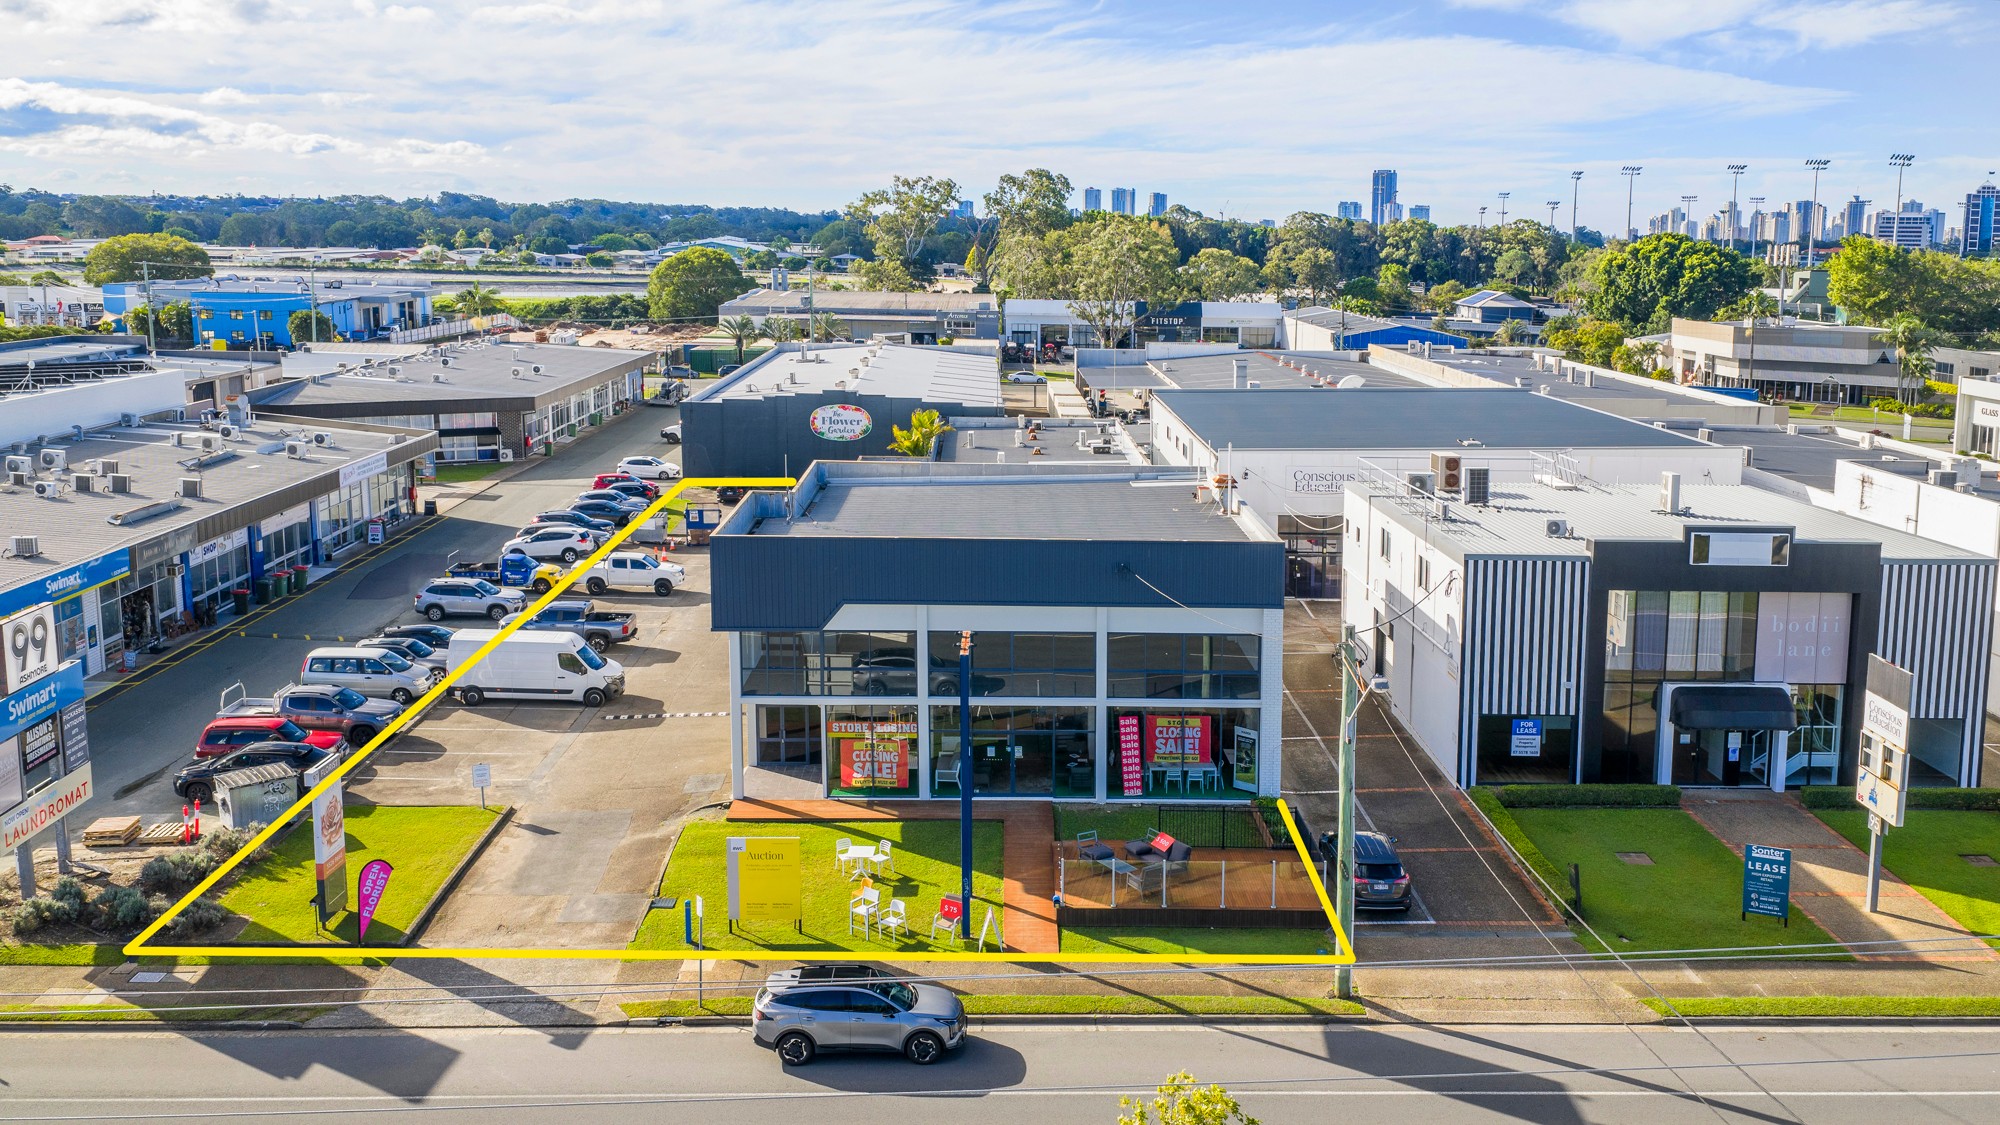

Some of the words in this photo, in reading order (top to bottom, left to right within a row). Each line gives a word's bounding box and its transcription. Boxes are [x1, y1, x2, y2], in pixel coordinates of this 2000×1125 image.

[832, 410, 843, 418] The
[1981, 407, 1999, 417] GLASS
[821, 416, 863, 425] Flower
[827, 426, 857, 434] Garden
[1293, 470, 1356, 482] Conscious
[203, 542, 217, 556] SHOP
[45, 570, 80, 595] Swimart
[1771, 614, 1839, 633] bodii
[11, 613, 48, 672] 99
[1777, 639, 1831, 657] lane
[20, 664, 48, 685] ASHMORE
[8, 681, 57, 721] Swimart
[1868, 700, 1903, 727] Conscious
[64, 714, 85, 731] ANTIQUES
[832, 722, 869, 733] STORE
[873, 723, 918, 733] CLOSING
[1868, 710, 1901, 738] Education
[26, 719, 53, 745] ALISON'S
[1155, 727, 1201, 738] CLOSNG
[852, 750, 899, 763] CLOSING
[320, 759, 338, 778] FLORIST
[853, 762, 897, 778] SALE!
[4, 781, 88, 848] LAUNDROMAT
[4, 815, 16, 827] NOW
[1869, 812, 1880, 830] 95
[746, 850, 784, 861] Auction
[1751, 845, 1785, 857] Sonter
[1747, 860, 1787, 875] LEASE
[362, 864, 381, 895] OPEN
[362, 871, 388, 918] FLORIST
[944, 904, 949, 912] $
[950, 905, 958, 914] 75
